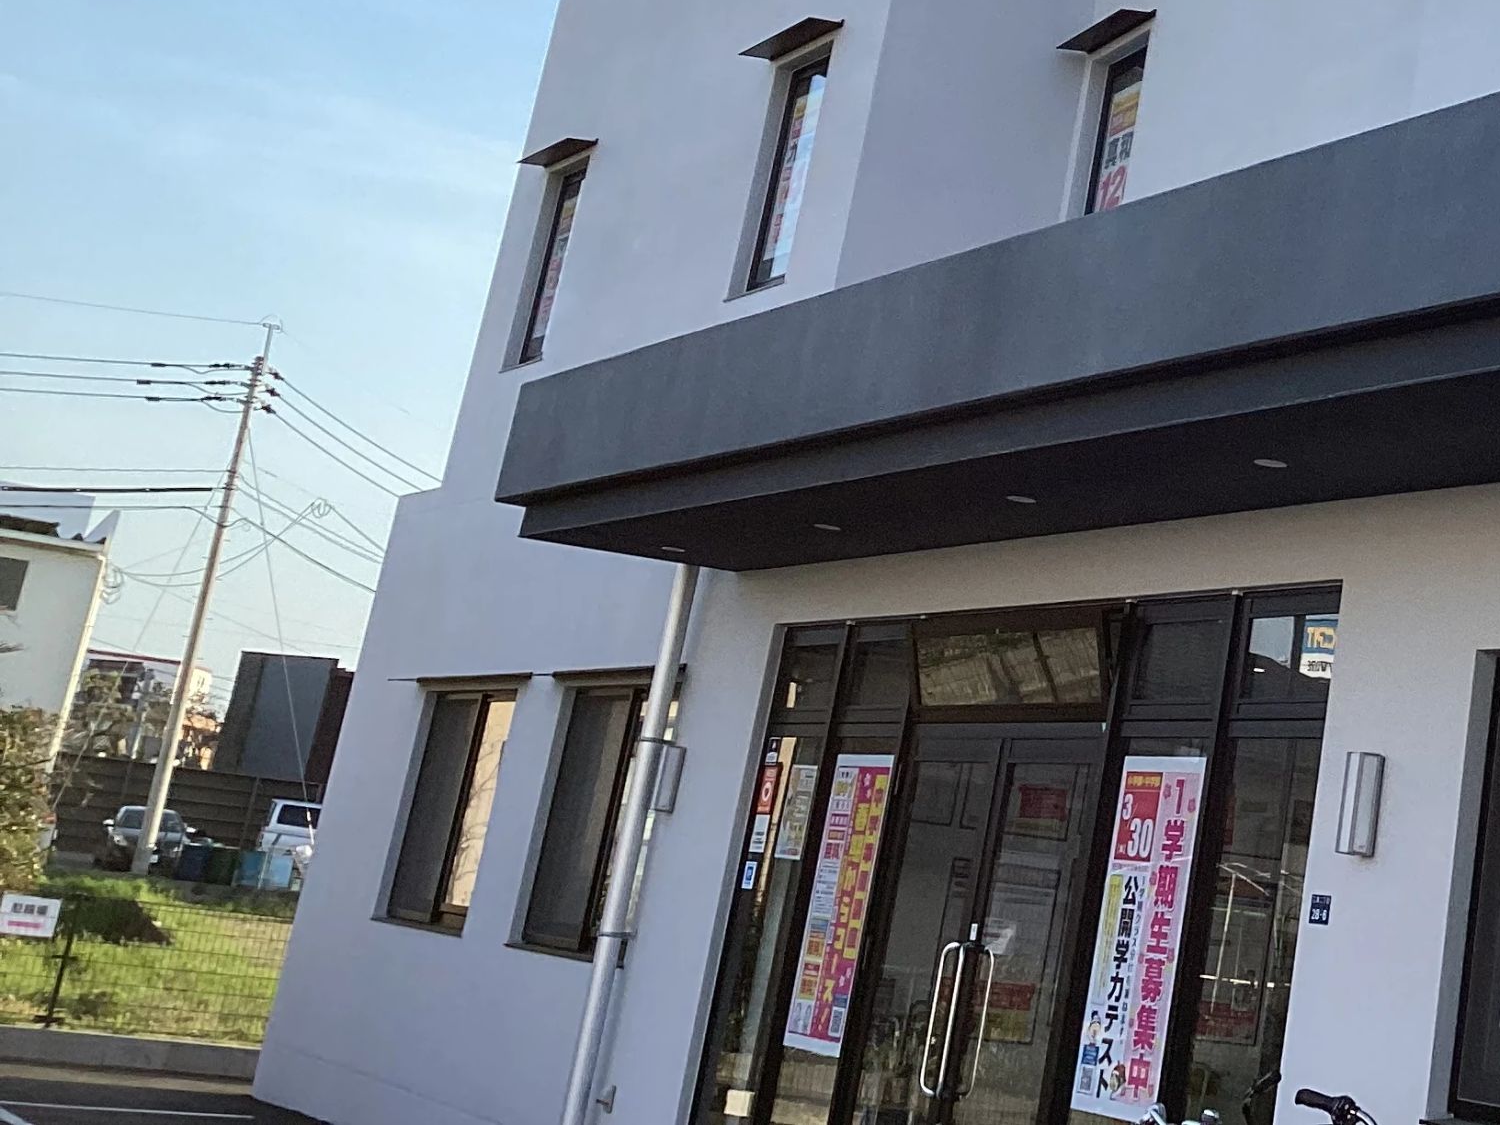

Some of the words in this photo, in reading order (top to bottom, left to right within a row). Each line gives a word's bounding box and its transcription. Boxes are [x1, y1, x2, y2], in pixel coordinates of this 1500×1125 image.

[1095, 875, 1139, 1098] 公開学力テスト
[1127, 778, 1186, 1099] 1学期生募集中
